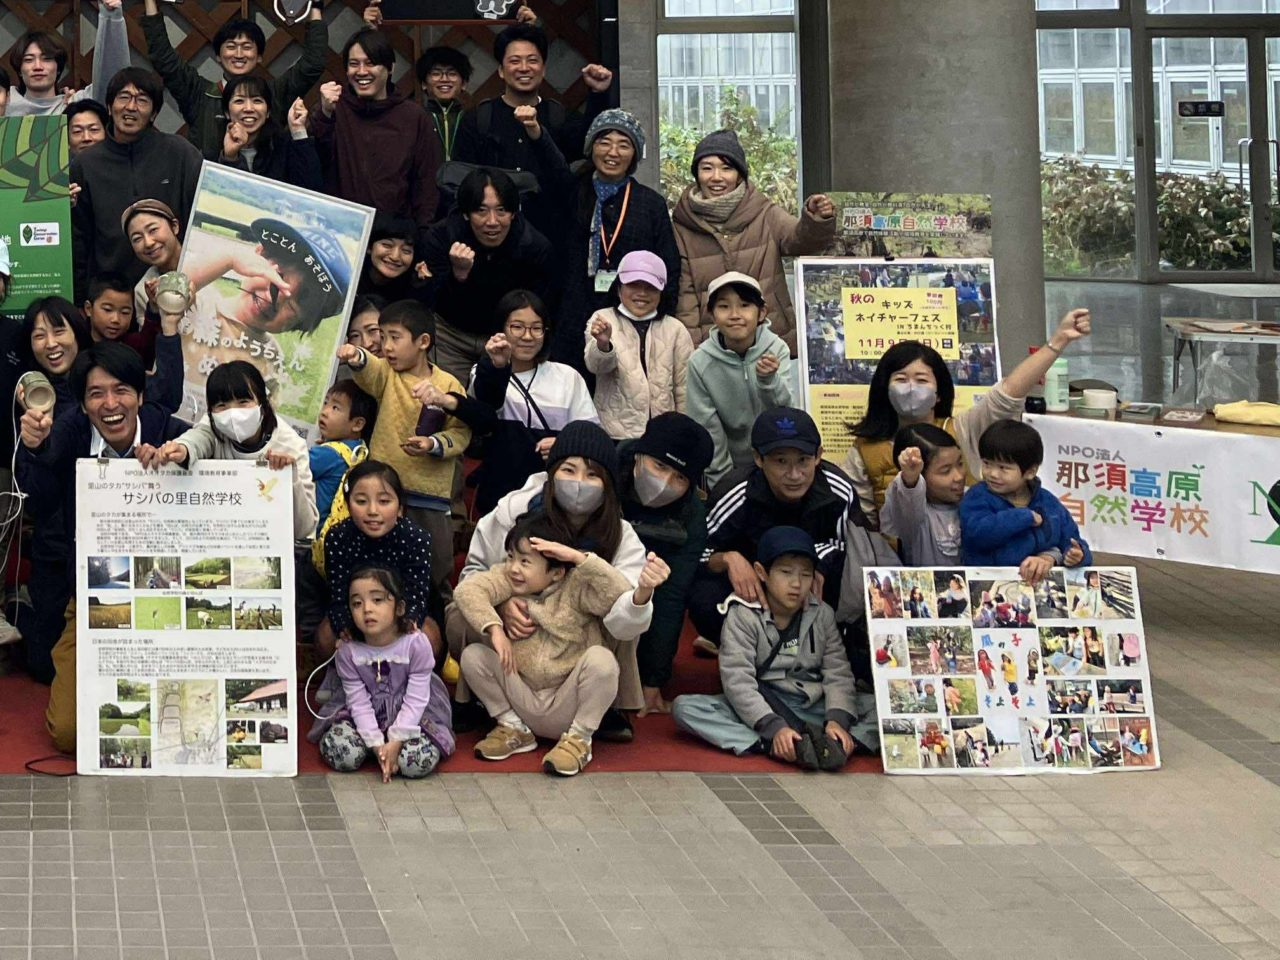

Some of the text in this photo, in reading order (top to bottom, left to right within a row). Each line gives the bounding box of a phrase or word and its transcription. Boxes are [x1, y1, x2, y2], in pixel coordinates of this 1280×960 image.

[261, 229, 297, 253] とことん
[304, 254, 333, 293] あそぼう
[850, 293, 875, 305] 秋の
[881, 300, 914, 309] キッズ
[855, 313, 941, 323] ネイチャーフェス
[1057, 444, 1126, 463] NPO法人
[1056, 460, 1206, 502] 那須高原
[122, 491, 243, 506] サシバの里自然学校
[1060, 492, 1210, 539] 自然学校
